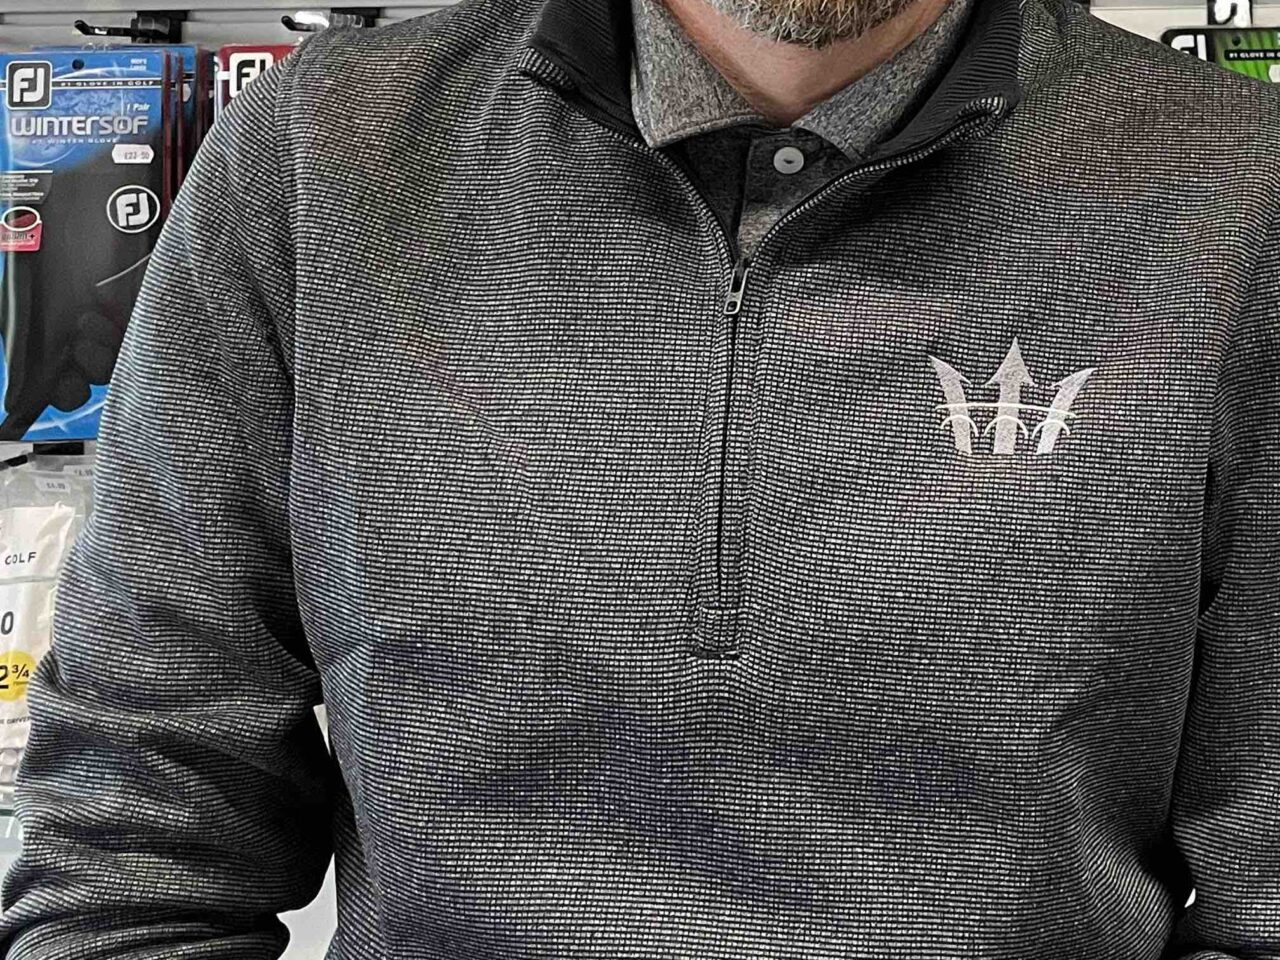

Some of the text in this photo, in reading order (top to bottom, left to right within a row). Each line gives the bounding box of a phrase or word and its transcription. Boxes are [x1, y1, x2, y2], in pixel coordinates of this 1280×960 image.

[13, 68, 45, 103] FJ
[132, 102, 151, 112] Pair
[116, 192, 150, 227] FJ
